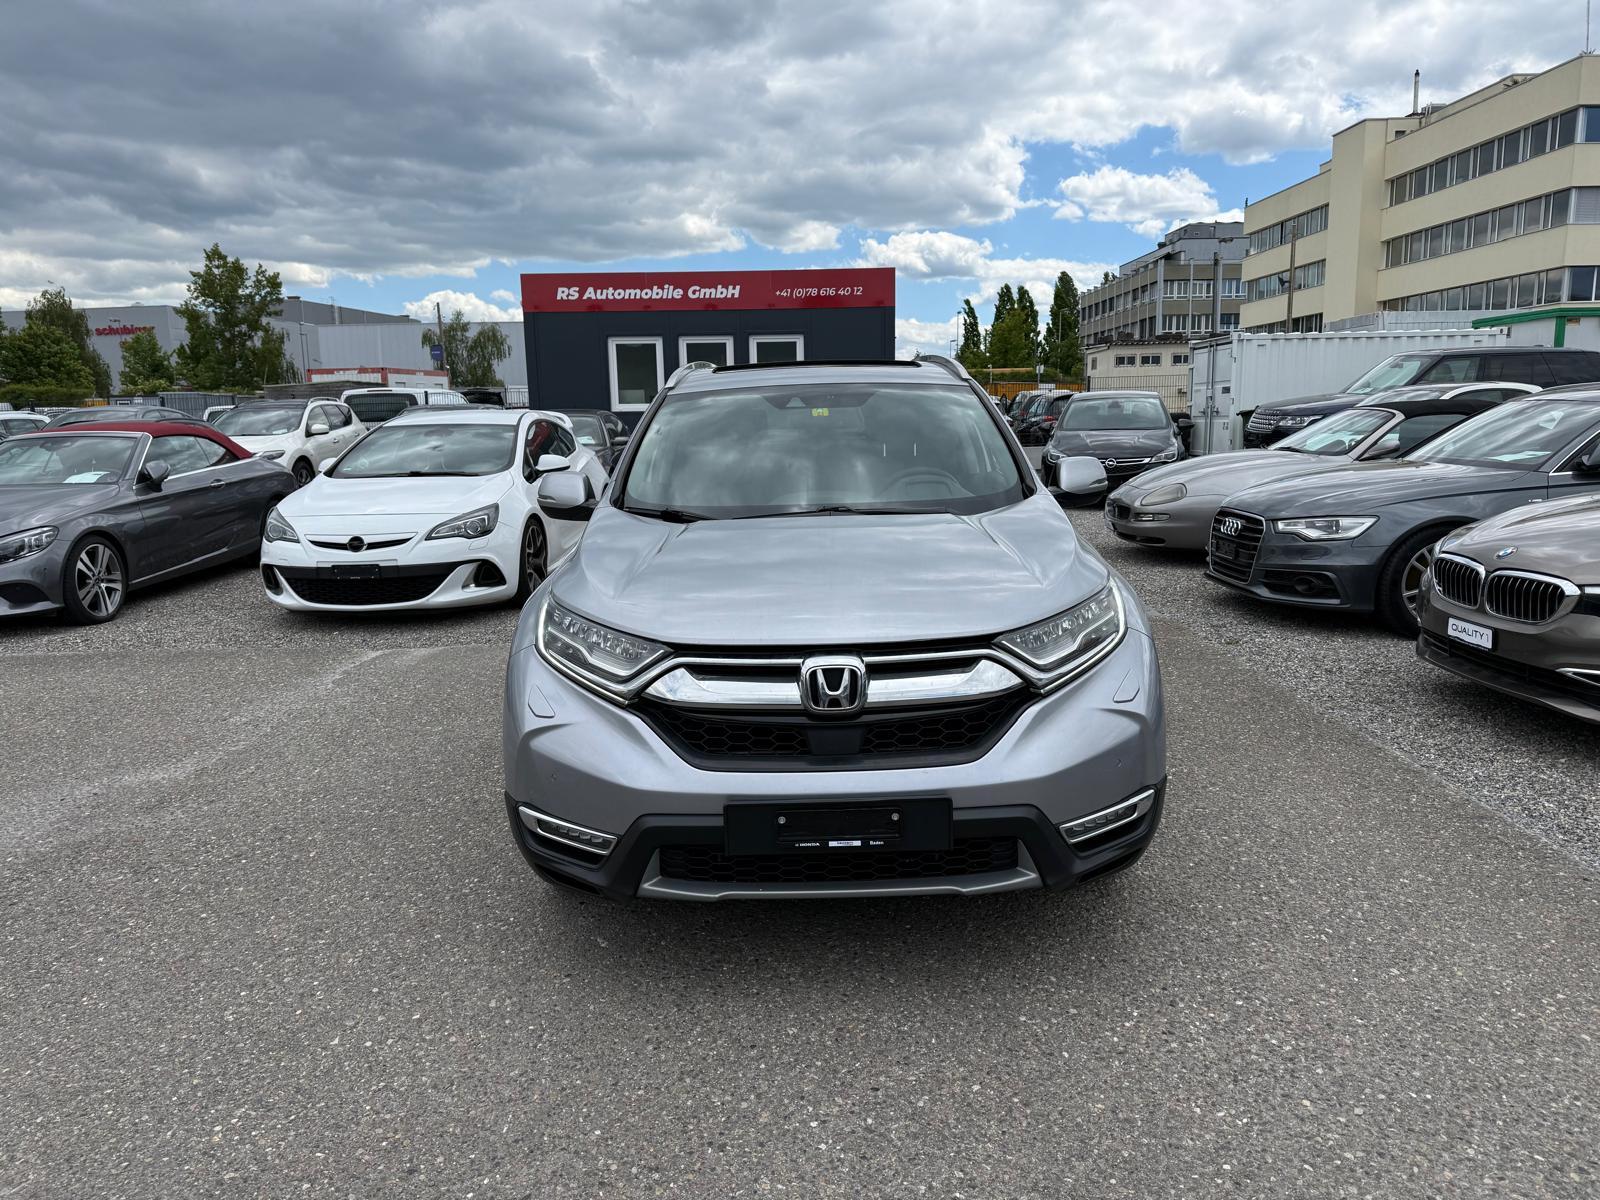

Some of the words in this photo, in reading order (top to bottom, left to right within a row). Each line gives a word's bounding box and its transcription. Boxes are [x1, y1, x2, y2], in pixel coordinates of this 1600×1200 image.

[556, 286, 580, 301] RS
[583, 284, 683, 300] Automobile
[687, 284, 741, 299] GmbH
[775, 287, 791, 297] +41
[793, 287, 818, 299] (0)78
[819, 287, 836, 296] 616
[837, 286, 852, 296] 40
[853, 286, 863, 295] 12
[1451, 623, 1485, 640] QUALITY
